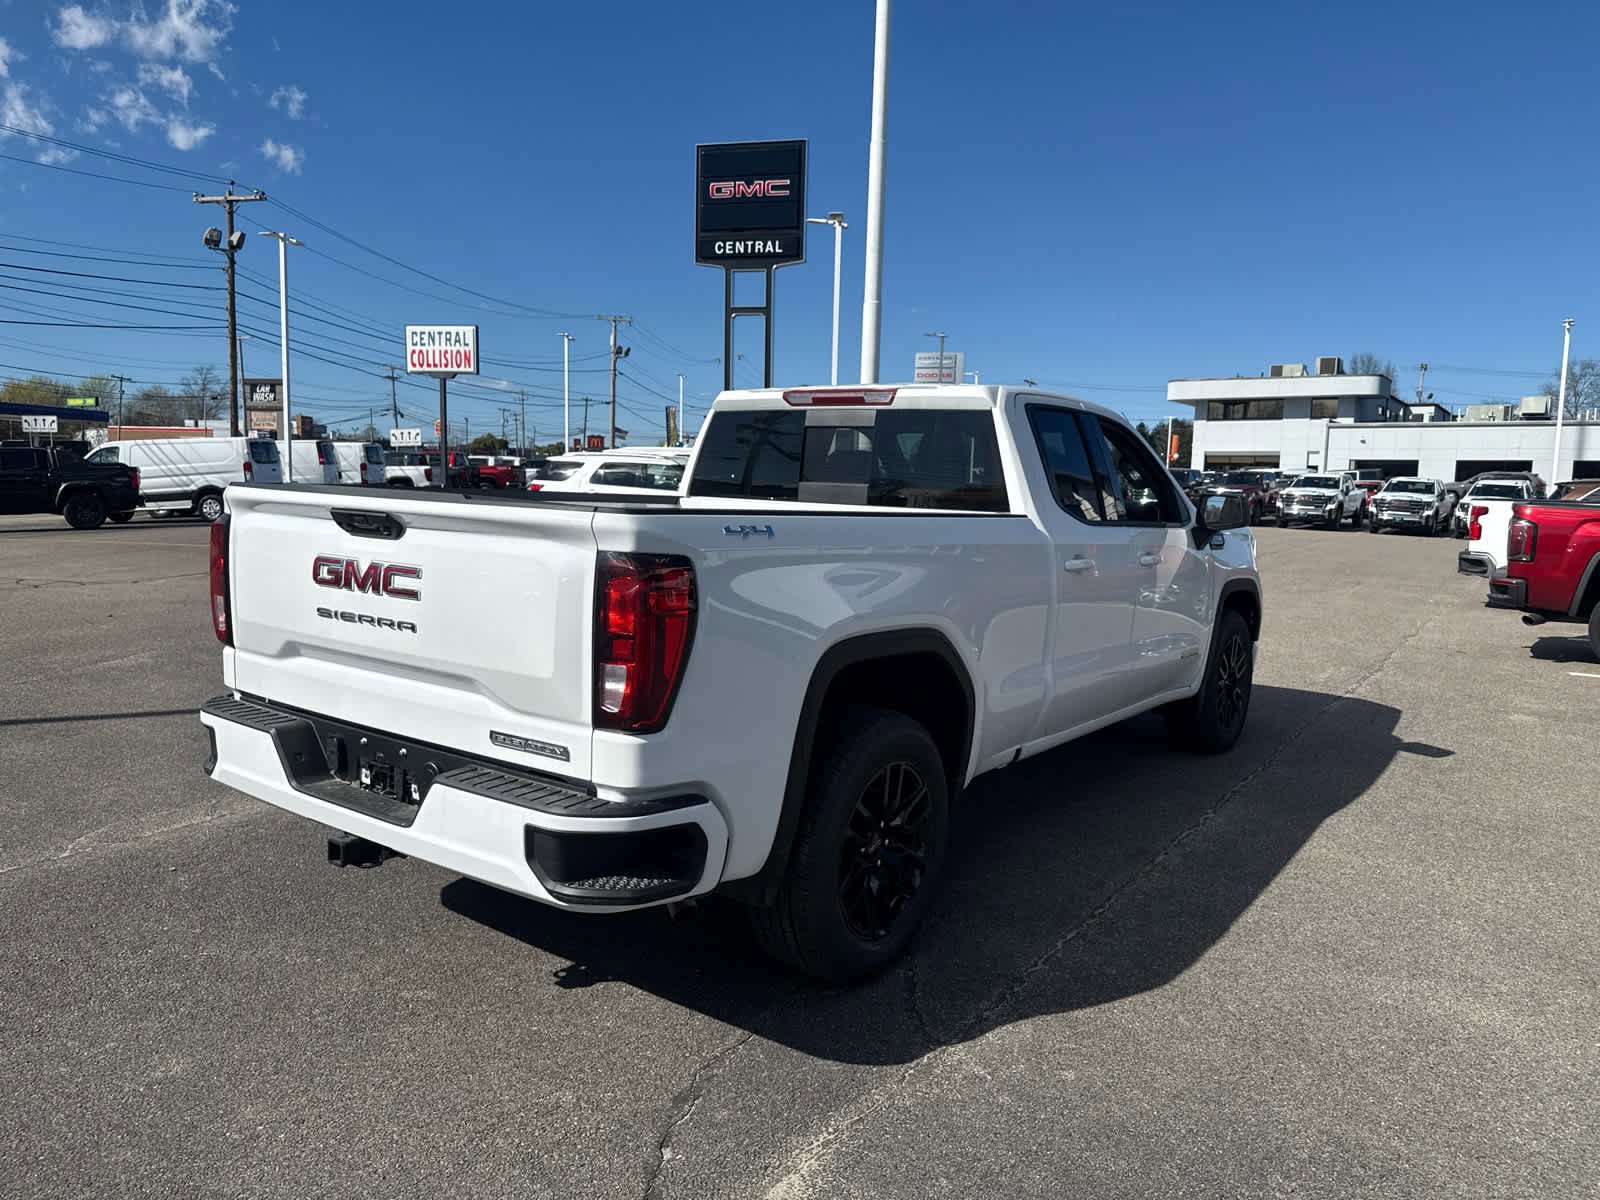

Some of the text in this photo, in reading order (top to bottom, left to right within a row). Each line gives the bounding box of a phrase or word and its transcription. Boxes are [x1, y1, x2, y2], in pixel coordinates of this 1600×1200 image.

[709, 179, 790, 198] GMC
[714, 240, 783, 254] CENTRAL
[411, 331, 469, 347] CENTRAL
[410, 349, 472, 368] COLLISION
[253, 392, 275, 401] WASH
[312, 554, 422, 601] GMC
[316, 606, 417, 633] SIERRA
